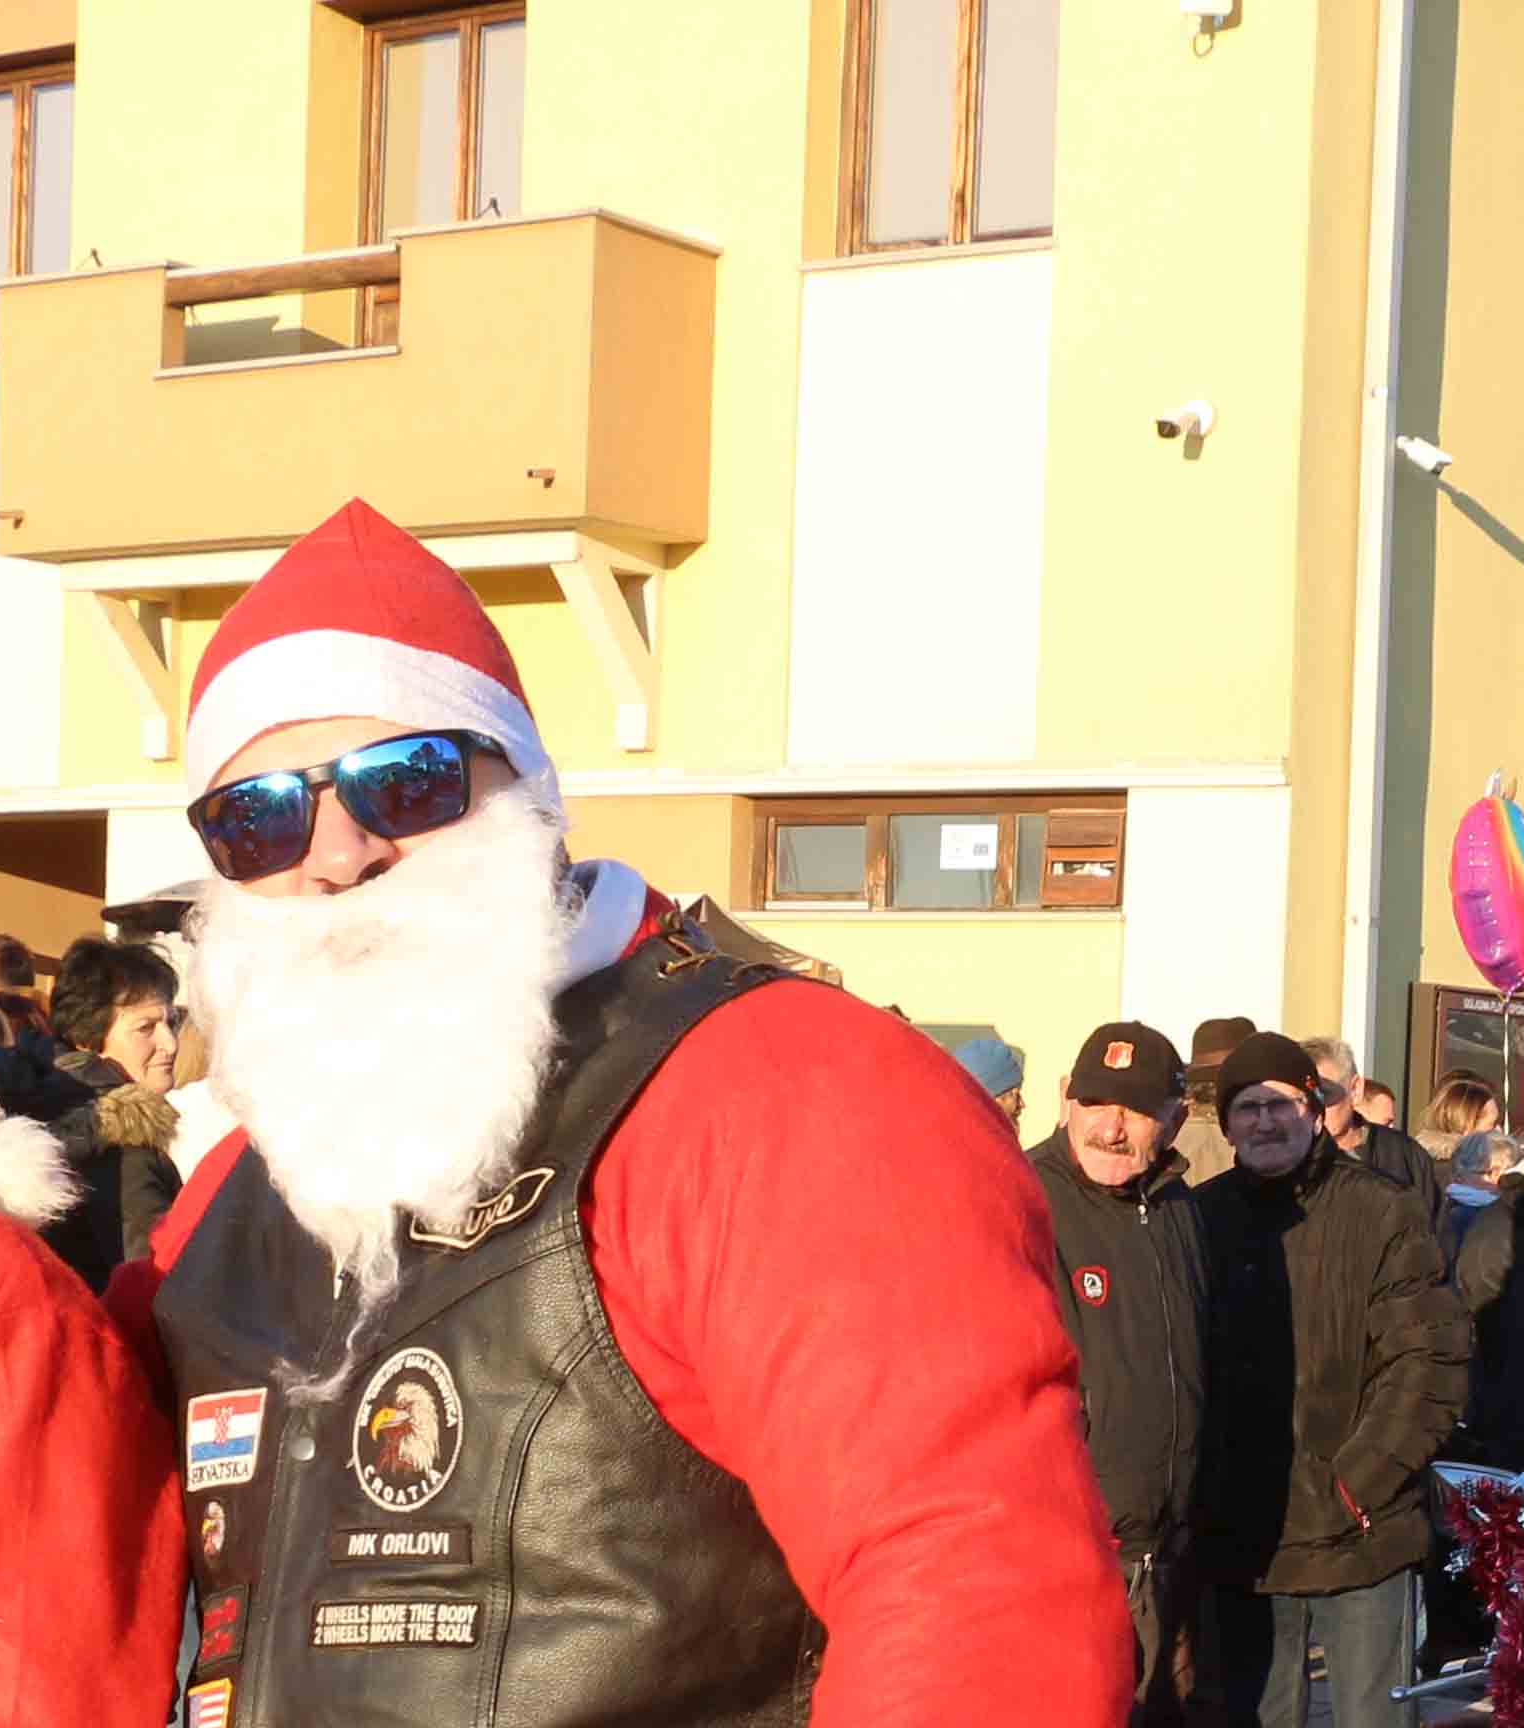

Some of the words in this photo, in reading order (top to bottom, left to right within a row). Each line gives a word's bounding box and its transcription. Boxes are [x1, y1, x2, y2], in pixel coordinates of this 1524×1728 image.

[191, 1461, 251, 1484] HRVATSKA
[364, 1464, 443, 1505] CROATIA
[348, 1534, 378, 1556] MK
[380, 1532, 450, 1556] ORLOVI
[316, 1606, 324, 1624] 4
[325, 1605, 370, 1625] WHEELS
[370, 1604, 407, 1624] MOVE
[407, 1603, 436, 1623] THE
[436, 1603, 478, 1624] BODY
[314, 1625, 323, 1644] 2
[323, 1624, 368, 1645] WHEELS
[369, 1624, 406, 1644] MOVE
[406, 1623, 435, 1642] THE
[435, 1623, 474, 1643] SOUL
